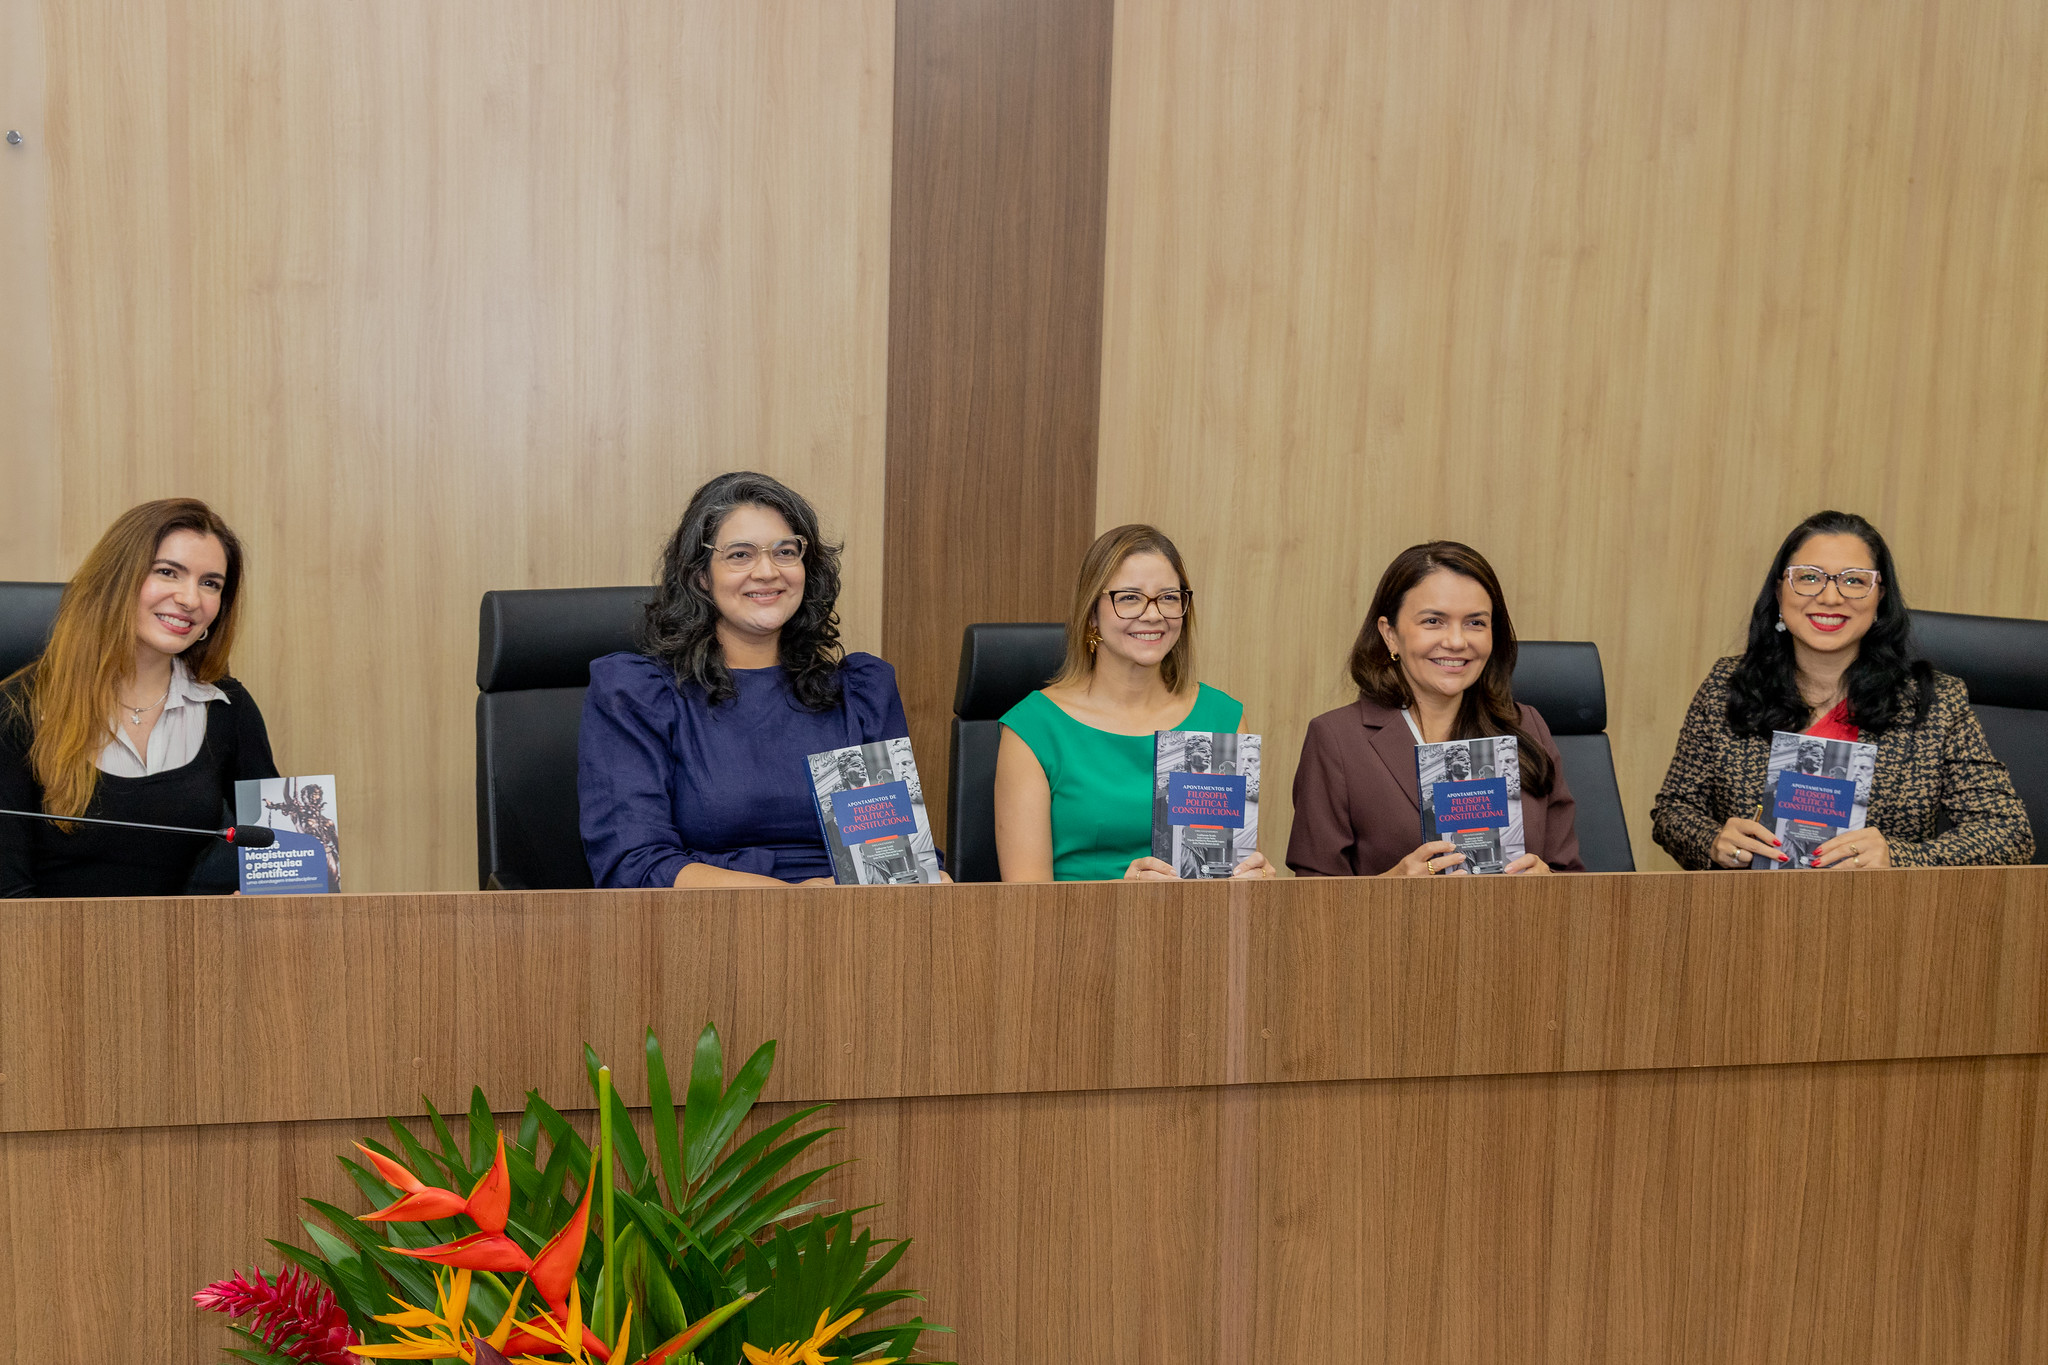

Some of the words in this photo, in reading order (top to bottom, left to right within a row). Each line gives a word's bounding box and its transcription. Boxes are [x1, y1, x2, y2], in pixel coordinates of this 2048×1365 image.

[1183, 784, 1225, 792] APONTAMENTOS
[1447, 790, 1487, 798] APONTAMENTOS
[1791, 783, 1833, 794] APONTAMENTOS
[1187, 790, 1228, 800] FILOSOFIA
[1795, 788, 1835, 801] FILOSOFIA
[847, 796, 889, 808] APONTAMENTOS
[1185, 797, 1222, 808] POLÍTICA
[1223, 800, 1229, 808] E
[1451, 796, 1490, 806] FILOSOFIA
[1829, 801, 1835, 809] E
[853, 801, 894, 815] FILOSOFIA
[1171, 806, 1240, 817] CONSTITUCIONAL
[1450, 804, 1486, 814] POLÍTICA
[1778, 801, 1847, 818] CONSTITUCIONAL
[854, 810, 891, 823] POLÍTICA
[891, 808, 897, 816] E
[1438, 810, 1505, 823] CONSTITUCIONAL
[843, 815, 912, 834] CONSTITUCIONAL
[245, 849, 315, 862] Magistratura
[245, 862, 253, 870] e
[254, 859, 303, 872] pesquisa
[246, 868, 299, 880] científica:
